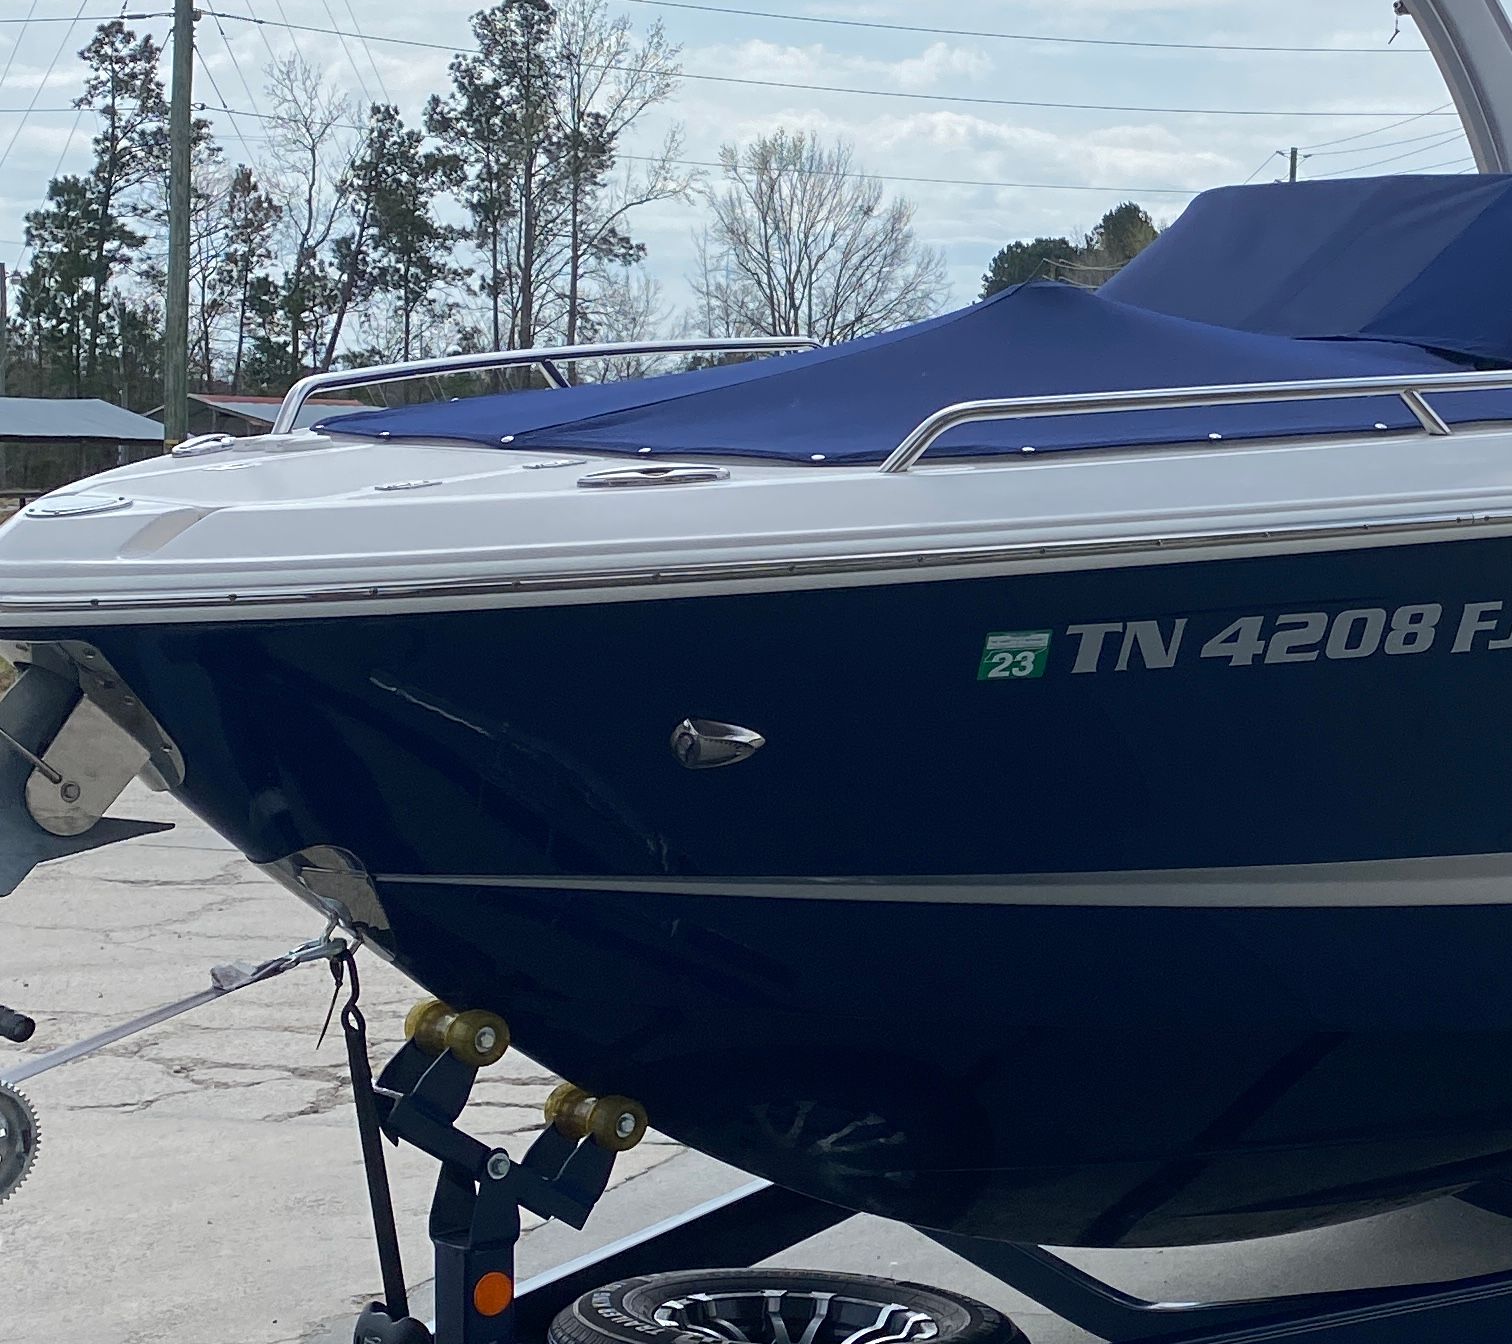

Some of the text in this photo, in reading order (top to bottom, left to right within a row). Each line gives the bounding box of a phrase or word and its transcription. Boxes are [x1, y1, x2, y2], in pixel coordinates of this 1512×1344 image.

[1066, 618, 1189, 674] TN
[1200, 603, 1442, 667] 4208
[988, 650, 1036, 678] 23
